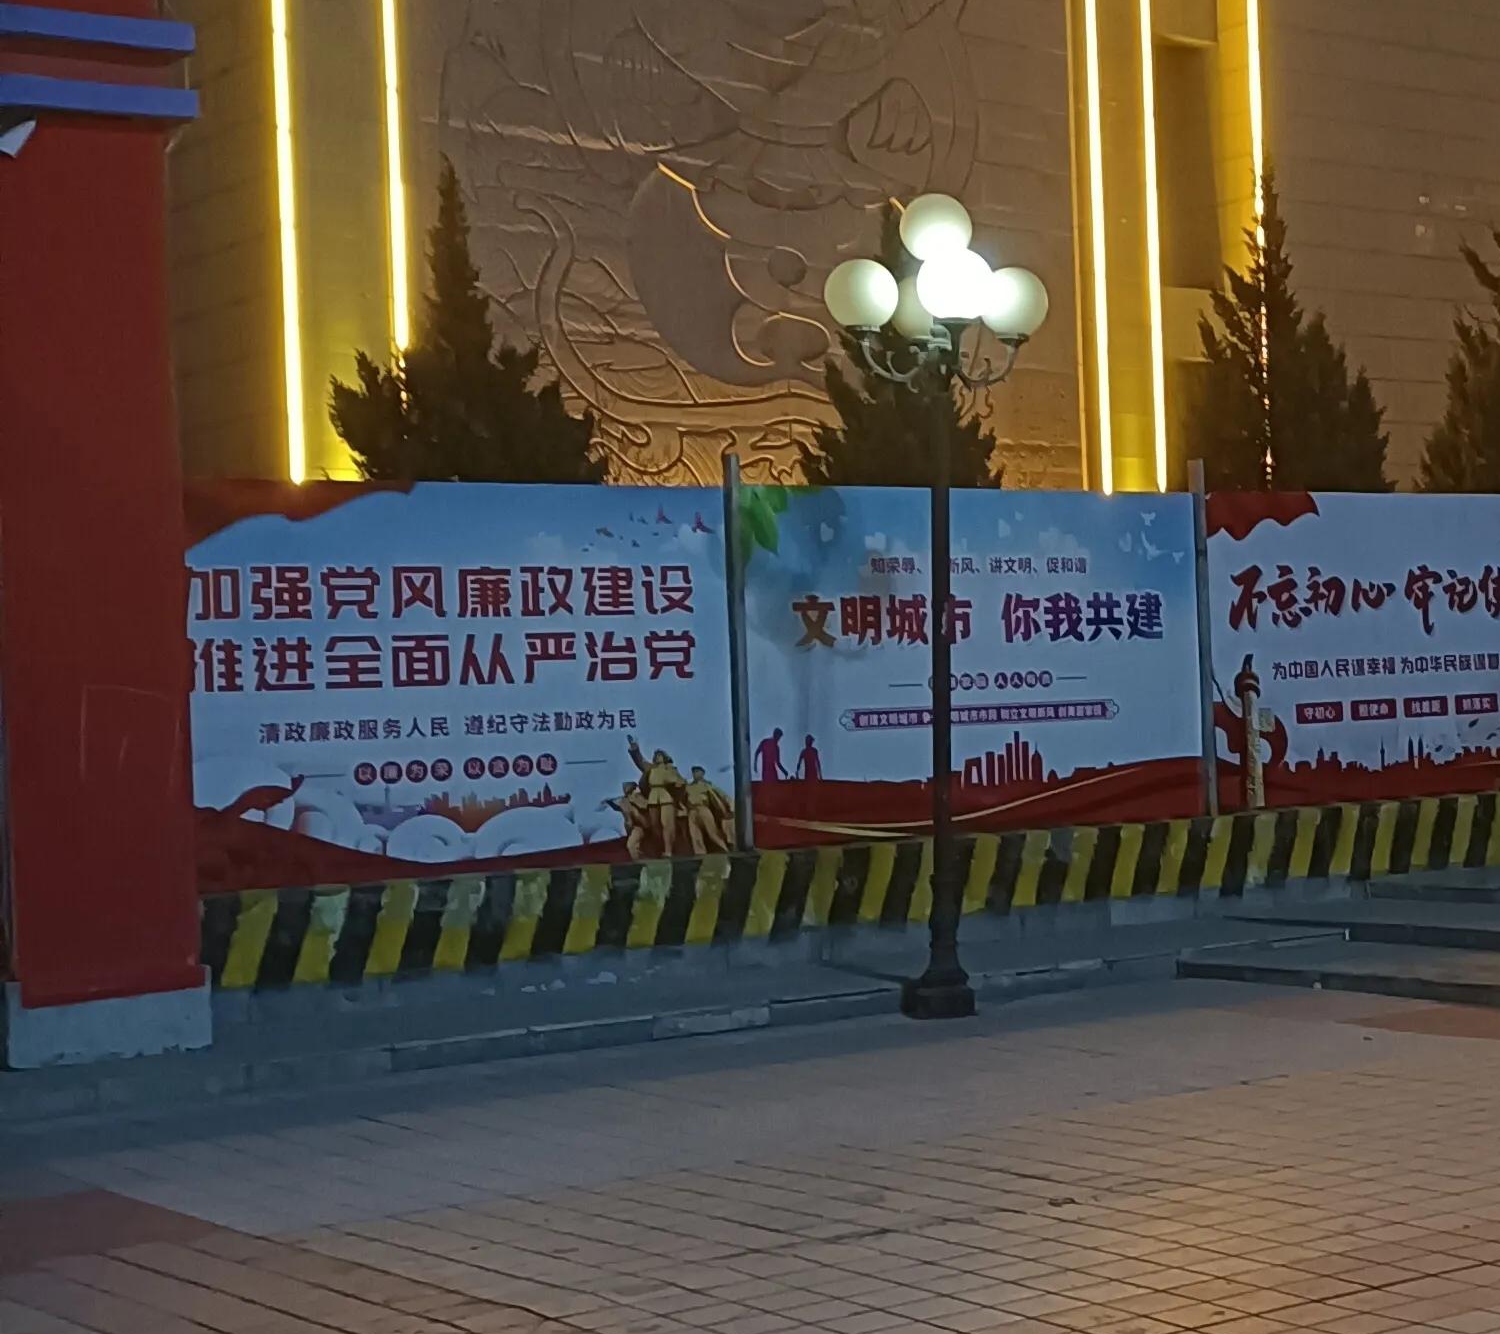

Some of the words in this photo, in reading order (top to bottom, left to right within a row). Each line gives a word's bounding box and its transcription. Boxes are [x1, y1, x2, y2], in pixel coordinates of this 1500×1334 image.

[871, 556, 1087, 575] 知荣辱、新风、讲文明、促和谐
[187, 565, 695, 621] 加强党风廉政建设
[793, 594, 973, 646] 文明城市
[1001, 592, 1164, 642] 你我共建
[1228, 563, 1396, 633] 不忘初心
[188, 631, 696, 692] 推进全面从严治党
[1272, 657, 1396, 680] 为中国人民谋幸福
[259, 717, 449, 744] 清政廉政服务人民
[464, 709, 637, 735] 遵纪守法勤政为民
